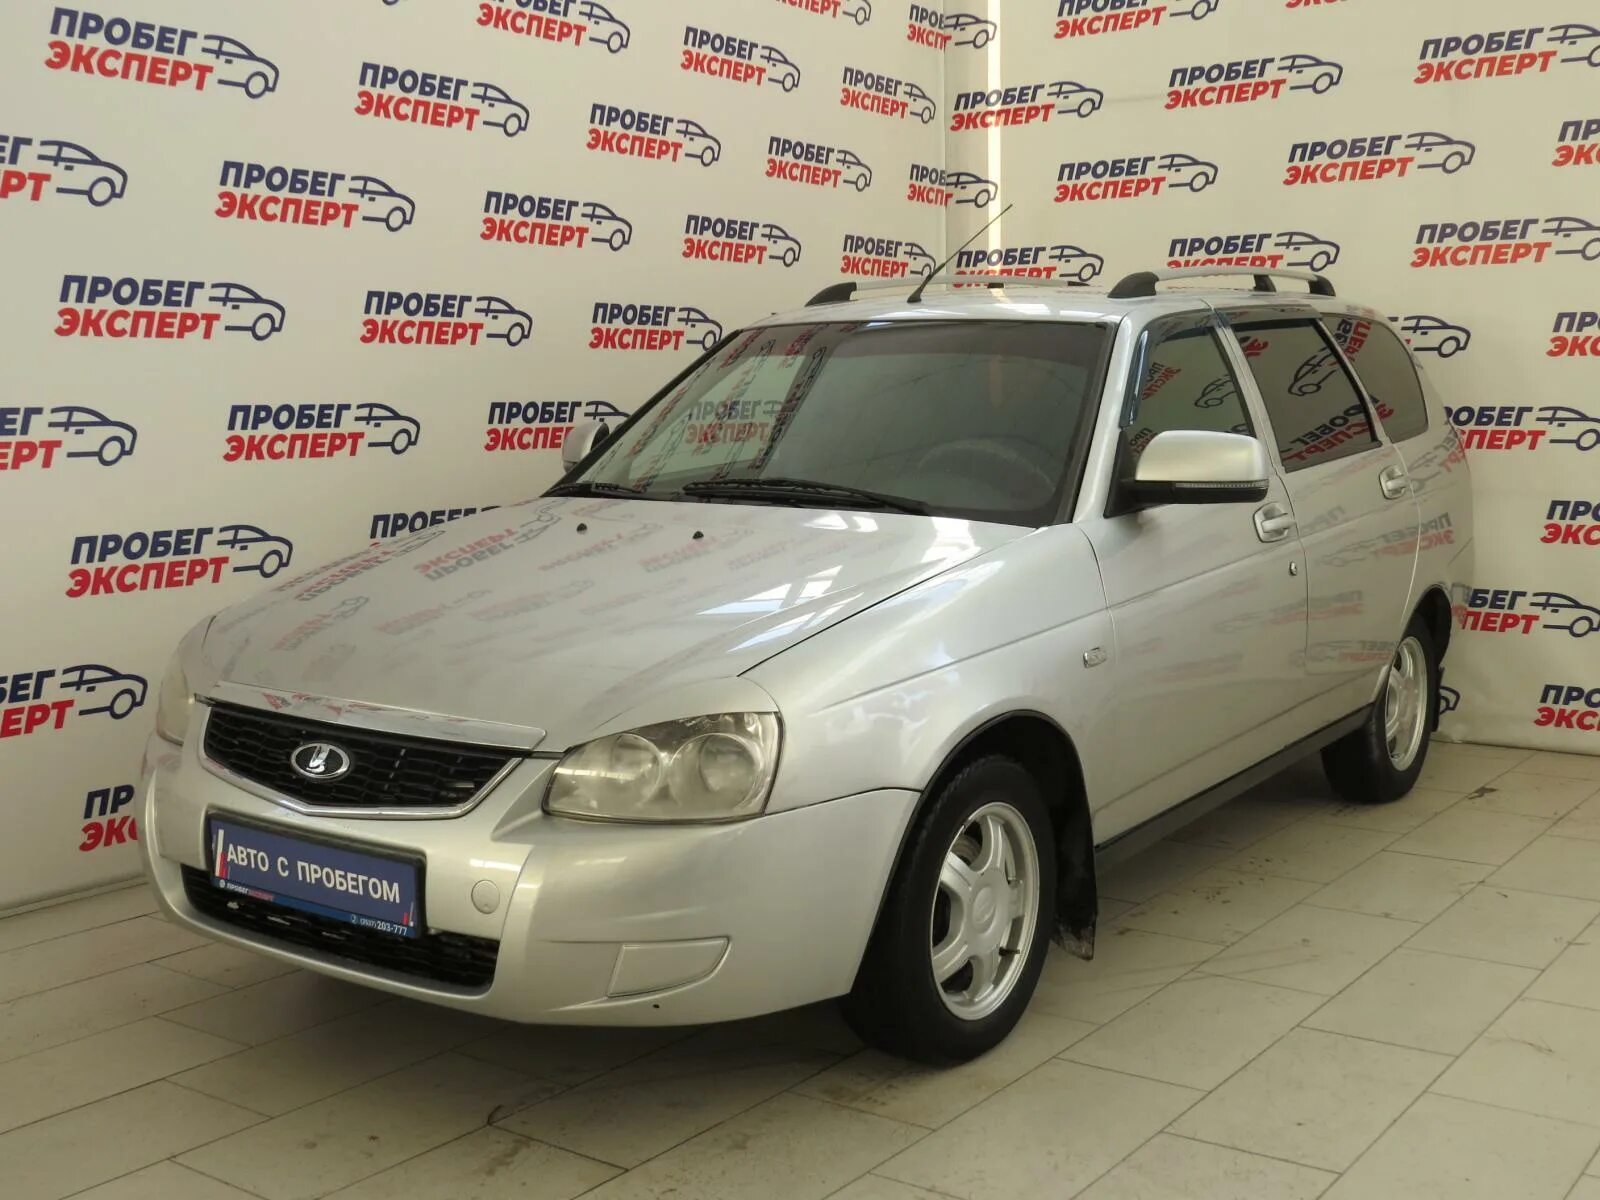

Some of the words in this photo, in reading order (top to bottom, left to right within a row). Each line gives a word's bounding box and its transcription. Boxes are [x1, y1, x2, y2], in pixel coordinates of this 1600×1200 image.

[491, 0, 577, 17] БЕГ
[776, 0, 841, 18] ПЕРТ
[1056, 5, 1167, 39] ЭКСПЕРТ
[1058, 0, 1147, 17] ПРОБ
[50, 7, 197, 56] ПРОБЕГ
[477, 2, 588, 46] ЭКСПЕРТ
[684, 26, 758, 60] ПРОБЕГ
[1420, 28, 1544, 60] ПРОБЕГ
[45, 41, 214, 91] ЭКСПЕРТ
[681, 49, 766, 84] ЭКСПЕРТ
[1169, 58, 1275, 87] ПРОБЕГ
[1414, 50, 1557, 84] ЭКСПЕРТ
[359, 62, 468, 101] ПРОБЕГ
[843, 67, 902, 96] ПРОБЕГ
[1165, 79, 1286, 111] ЭКСПЕРТ
[354, 90, 480, 131] ЭКСПЕРТ
[841, 87, 908, 117] ЭКСПЕРТ
[954, 84, 1045, 111] ПРОБЕГ
[590, 104, 674, 136] ПРОБЕГ
[950, 102, 1055, 132] ЭКСПЕРТ
[586, 128, 684, 160] ЭКСПЕРТ
[768, 136, 834, 165] ПРОБЕГ
[1288, 135, 1402, 163] ПРОБЕГ
[1552, 144, 1600, 166] ЭК
[220, 161, 345, 197] ПРОБЕГ
[766, 158, 842, 186] ЭКСПЕРТ
[1058, 156, 1155, 181] ПРОБЕГ
[1283, 156, 1414, 185] ЭКСПЕРТ
[1055, 176, 1167, 203] ЭКСПЕРТ
[215, 191, 360, 228] ЭКСПЕРТ
[484, 191, 579, 221] ПРОБЕГ
[481, 216, 588, 248] ЭКСПЕРТ
[685, 215, 759, 241] ПРОБЕГ
[1416, 219, 1539, 244] ПРОБЕГ
[683, 237, 767, 264] ЭКСПЕРТ
[843, 235, 902, 258] ПРОБЕГ
[956, 247, 1046, 268] ПРОБЕГ
[1168, 233, 1272, 257] ПРОБЕГ
[1411, 242, 1552, 268] ЭКСПЕРТ
[841, 256, 908, 277] ЭКСПЕРТ
[60, 275, 205, 307] ПРОБЕГ
[364, 291, 472, 318] ПРОБЕГ
[55, 307, 221, 340] ЭКСПЕРТ
[592, 302, 675, 326] ПРОБЕГ
[1551, 311, 1600, 333] ПР
[360, 318, 484, 346] ЭКСПЕРТ
[589, 327, 684, 351] ЭКСПЕРТ
[228, 404, 351, 431] ПРОБЕГ
[488, 401, 582, 424] ПРОБЕГ
[224, 432, 366, 462] ЭКСПЕРТ
[1457, 428, 1546, 450] ПЕРТ
[71, 527, 214, 565] ПРОБЕГ
[67, 556, 230, 598] ЭКСПЕРТ
[0, 669, 56, 704] ЕГ
[0, 699, 75, 739] ЕРТ
[1536, 706, 1600, 731] ЭКС
[227, 843, 269, 872] АВТО
[277, 857, 289, 877] С
[297, 861, 400, 903] ПРОБЕГОМ
